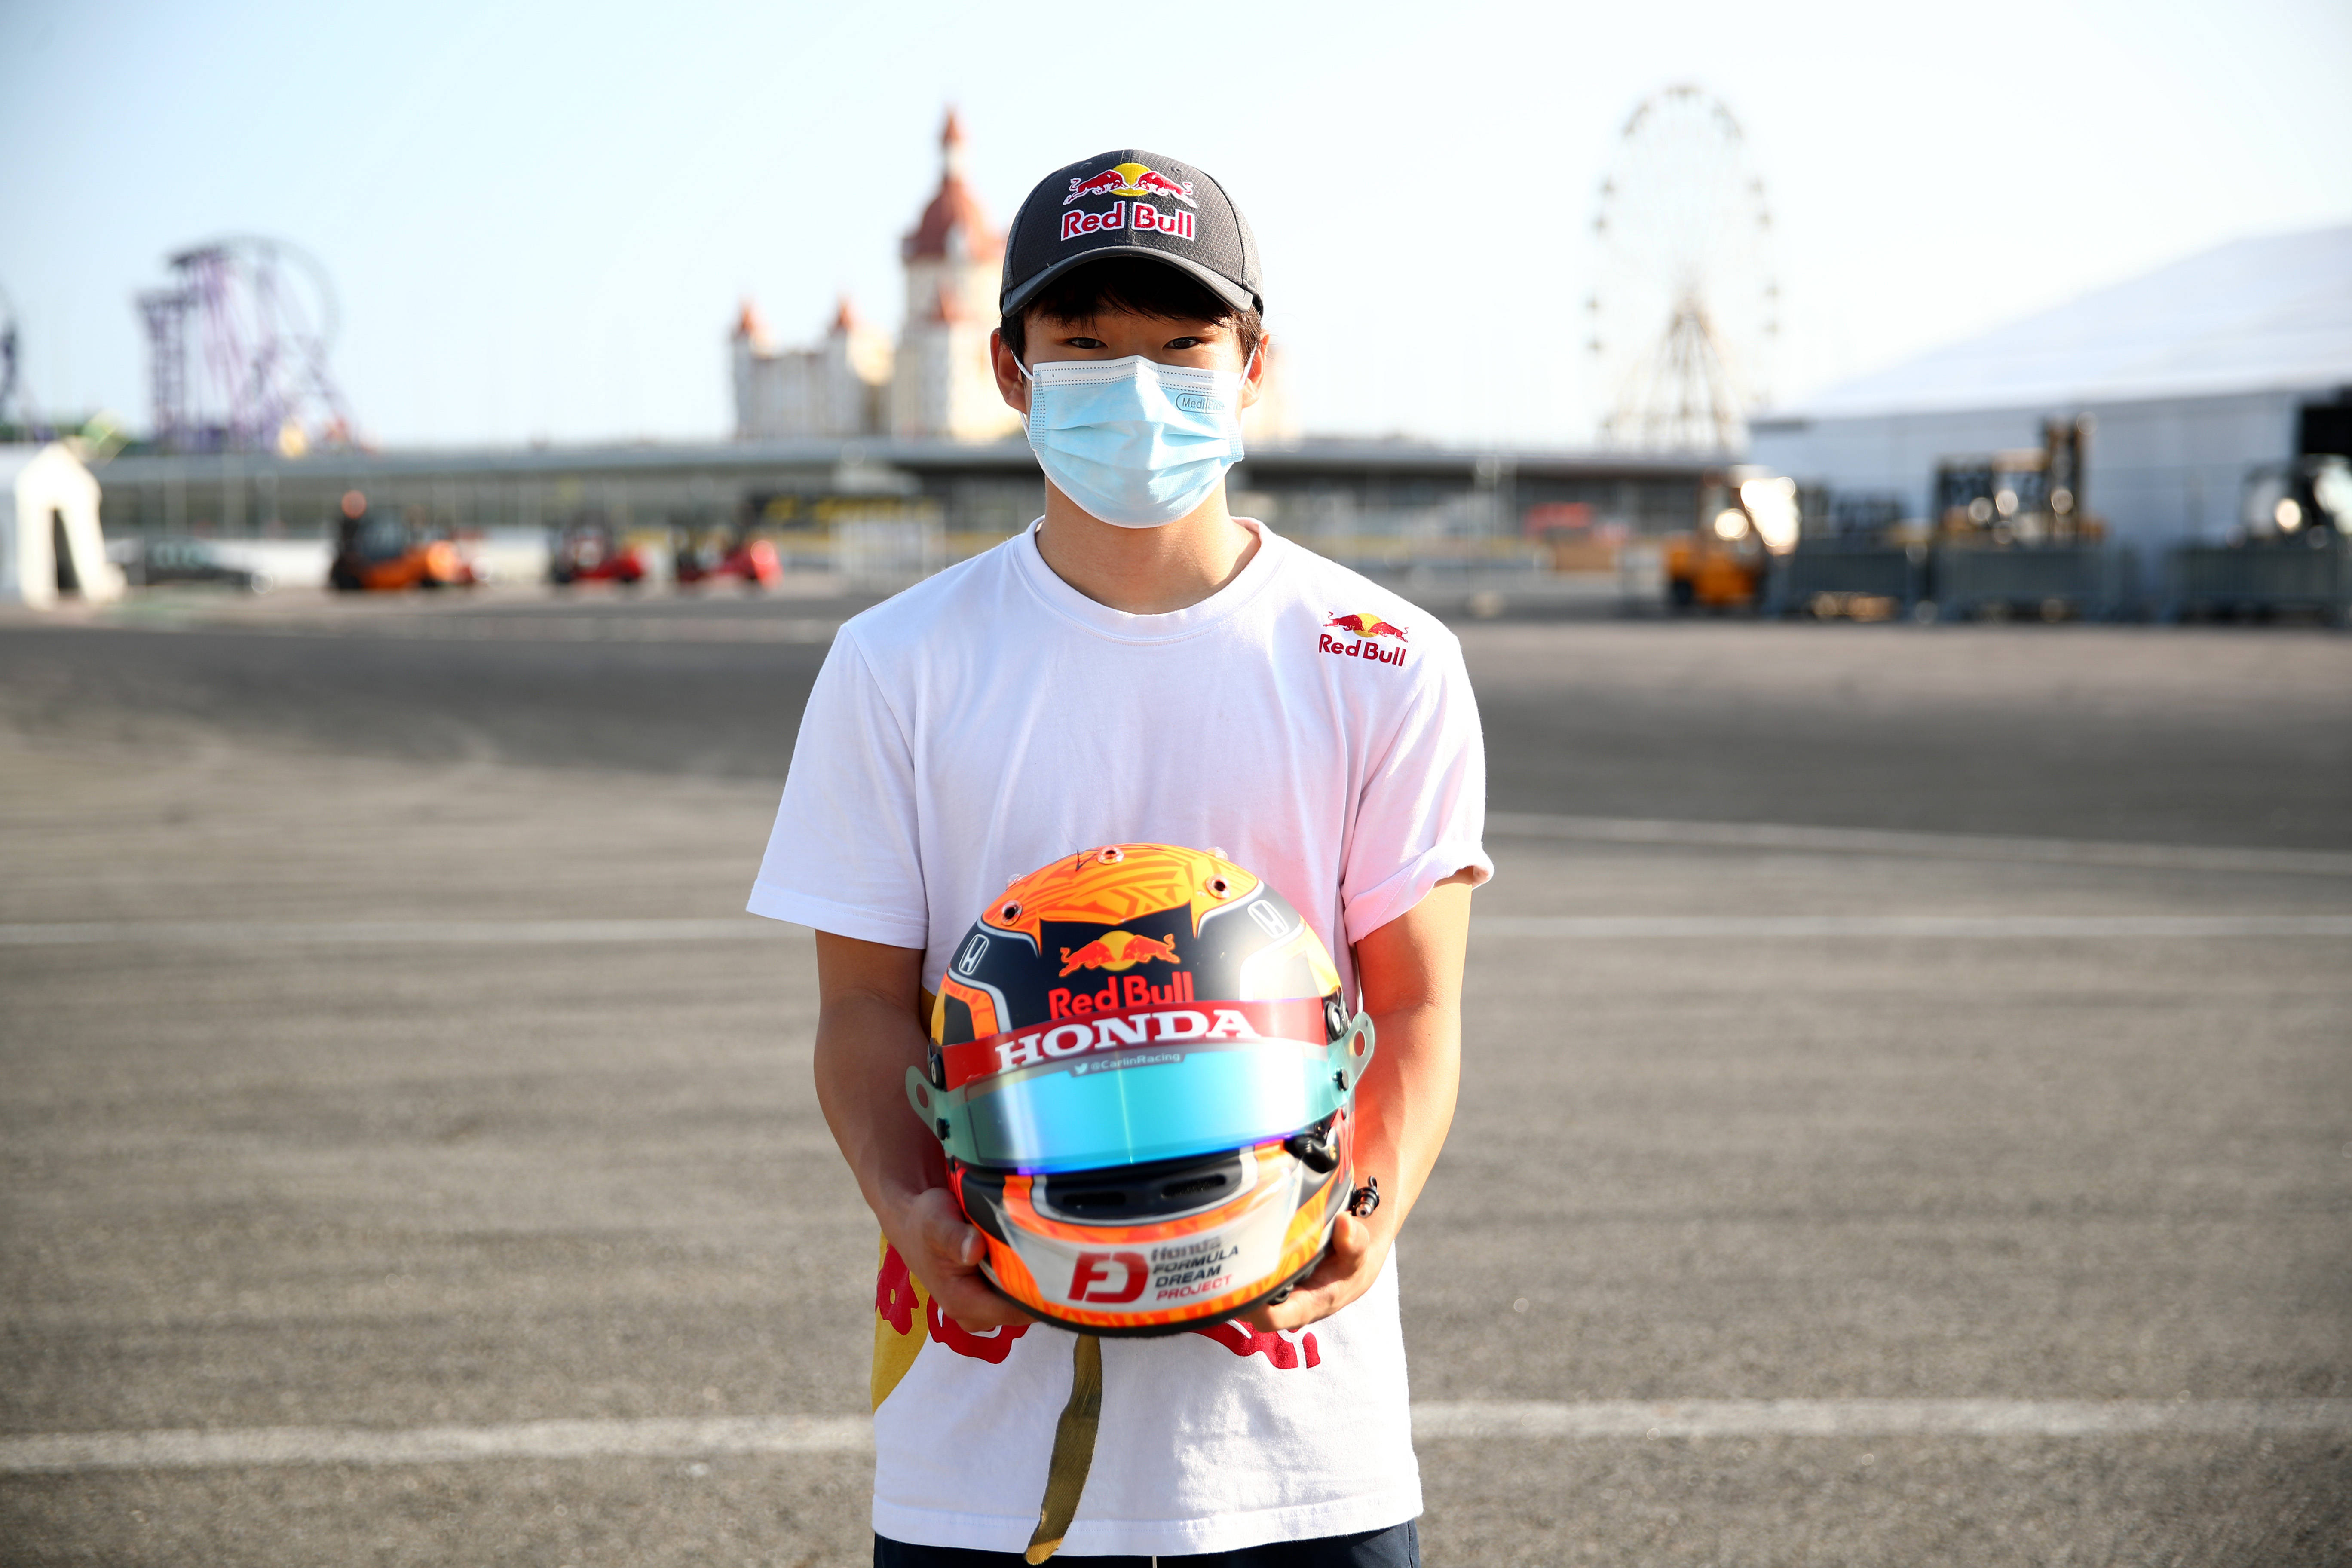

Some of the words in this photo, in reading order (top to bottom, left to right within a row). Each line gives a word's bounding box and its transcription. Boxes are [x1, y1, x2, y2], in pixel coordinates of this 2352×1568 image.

[1063, 202, 1123, 239] Red
[1134, 204, 1192, 238] Bull
[1182, 397, 1205, 409] Medi
[1319, 634, 1361, 657] Red
[1362, 642, 1406, 667] Bull
[1048, 975, 1120, 1020] Red
[1123, 971, 1195, 1007] Bull
[995, 1009, 1261, 1074] HONDA
[1153, 1244, 1238, 1274] FORMULA
[1155, 1264, 1222, 1288] DREAM
[1156, 1274, 1232, 1301] PROJECT
